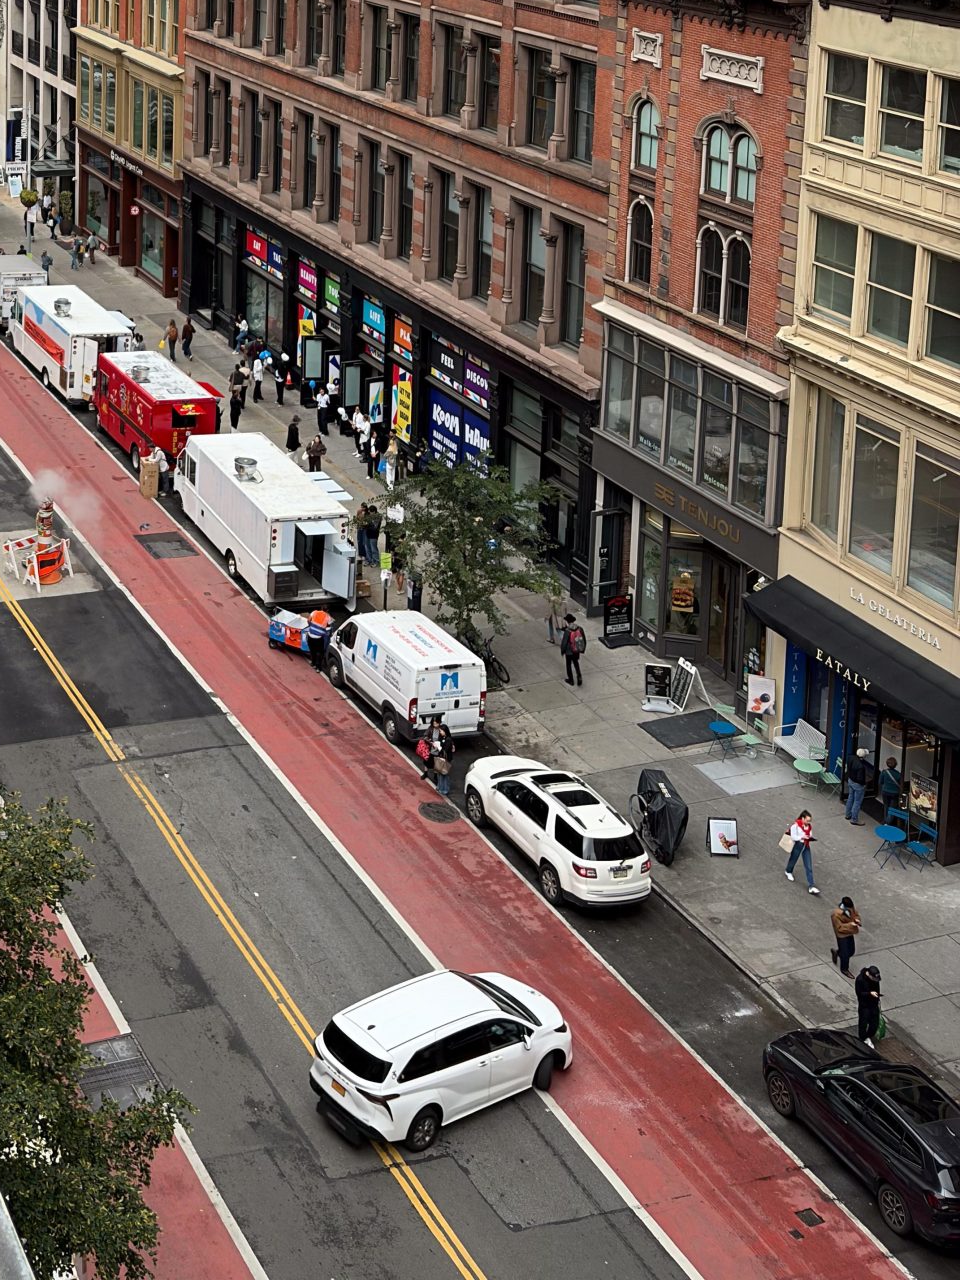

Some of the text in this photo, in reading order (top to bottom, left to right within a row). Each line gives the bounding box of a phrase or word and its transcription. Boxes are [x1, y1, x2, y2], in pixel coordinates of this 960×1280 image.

[253, 238, 262, 251] EAT
[300, 267, 318, 287] BEAUTY
[328, 284, 340, 298] TOU
[369, 308, 381, 325] LIFE
[440, 352, 455, 370] FEEL
[679, 495, 740, 545] TENJOU
[850, 587, 942, 651] LA GELATERIA
[792, 645, 800, 694] TALY
[816, 648, 871, 692] EATALY
